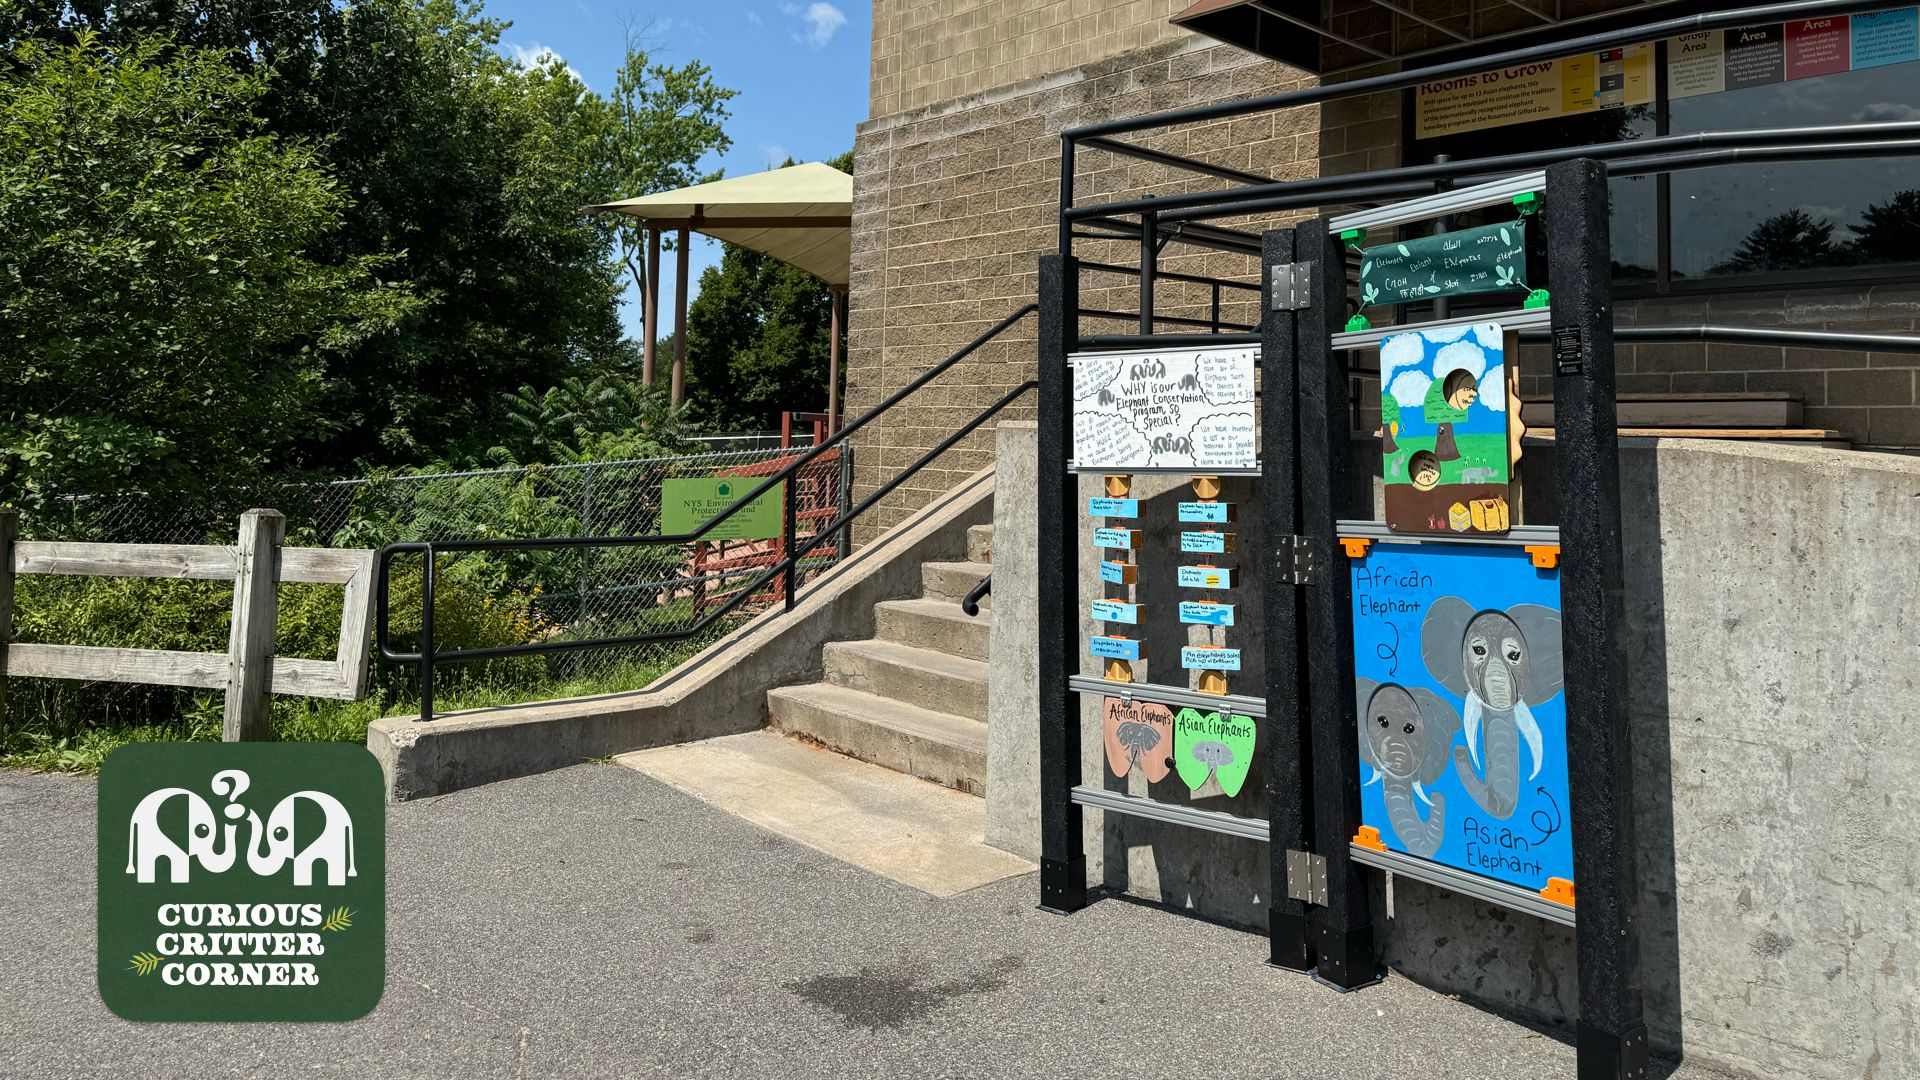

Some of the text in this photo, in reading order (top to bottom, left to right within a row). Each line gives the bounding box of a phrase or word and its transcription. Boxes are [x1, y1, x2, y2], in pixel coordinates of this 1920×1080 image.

[1803, 19, 1831, 31] Area
[1682, 43, 1706, 53] Area
[1740, 32, 1766, 43] Area
[1421, 76, 1477, 95] Rooms
[1482, 73, 1498, 83] to
[1504, 62, 1552, 79] Grow
[1424, 105, 1457, 114] environment
[1463, 99, 1488, 108] equipped
[1496, 93, 1520, 102] continue
[1532, 87, 1555, 96] tradition
[1440, 109, 1477, 120] internationally
[1478, 104, 1508, 114] recognized
[1509, 100, 1533, 109] elephant
[1448, 119, 1470, 128] program
[1488, 111, 1516, 120] Rosamond
[1517, 107, 1537, 115] Gifford
[1120, 381, 1146, 396] WHY
[1159, 383, 1176, 394] our
[1116, 393, 1205, 412] Elephant Conservation
[683, 500, 702, 508] NYS
[739, 506, 756, 514] und
[1356, 566, 1432, 590] African
[1360, 594, 1422, 618] Elephant
[1110, 703, 1171, 726] African Elephants
[1179, 715, 1251, 738] Asian Elephants
[1464, 817, 1529, 852] Asian
[1466, 842, 1542, 877] Elephant
